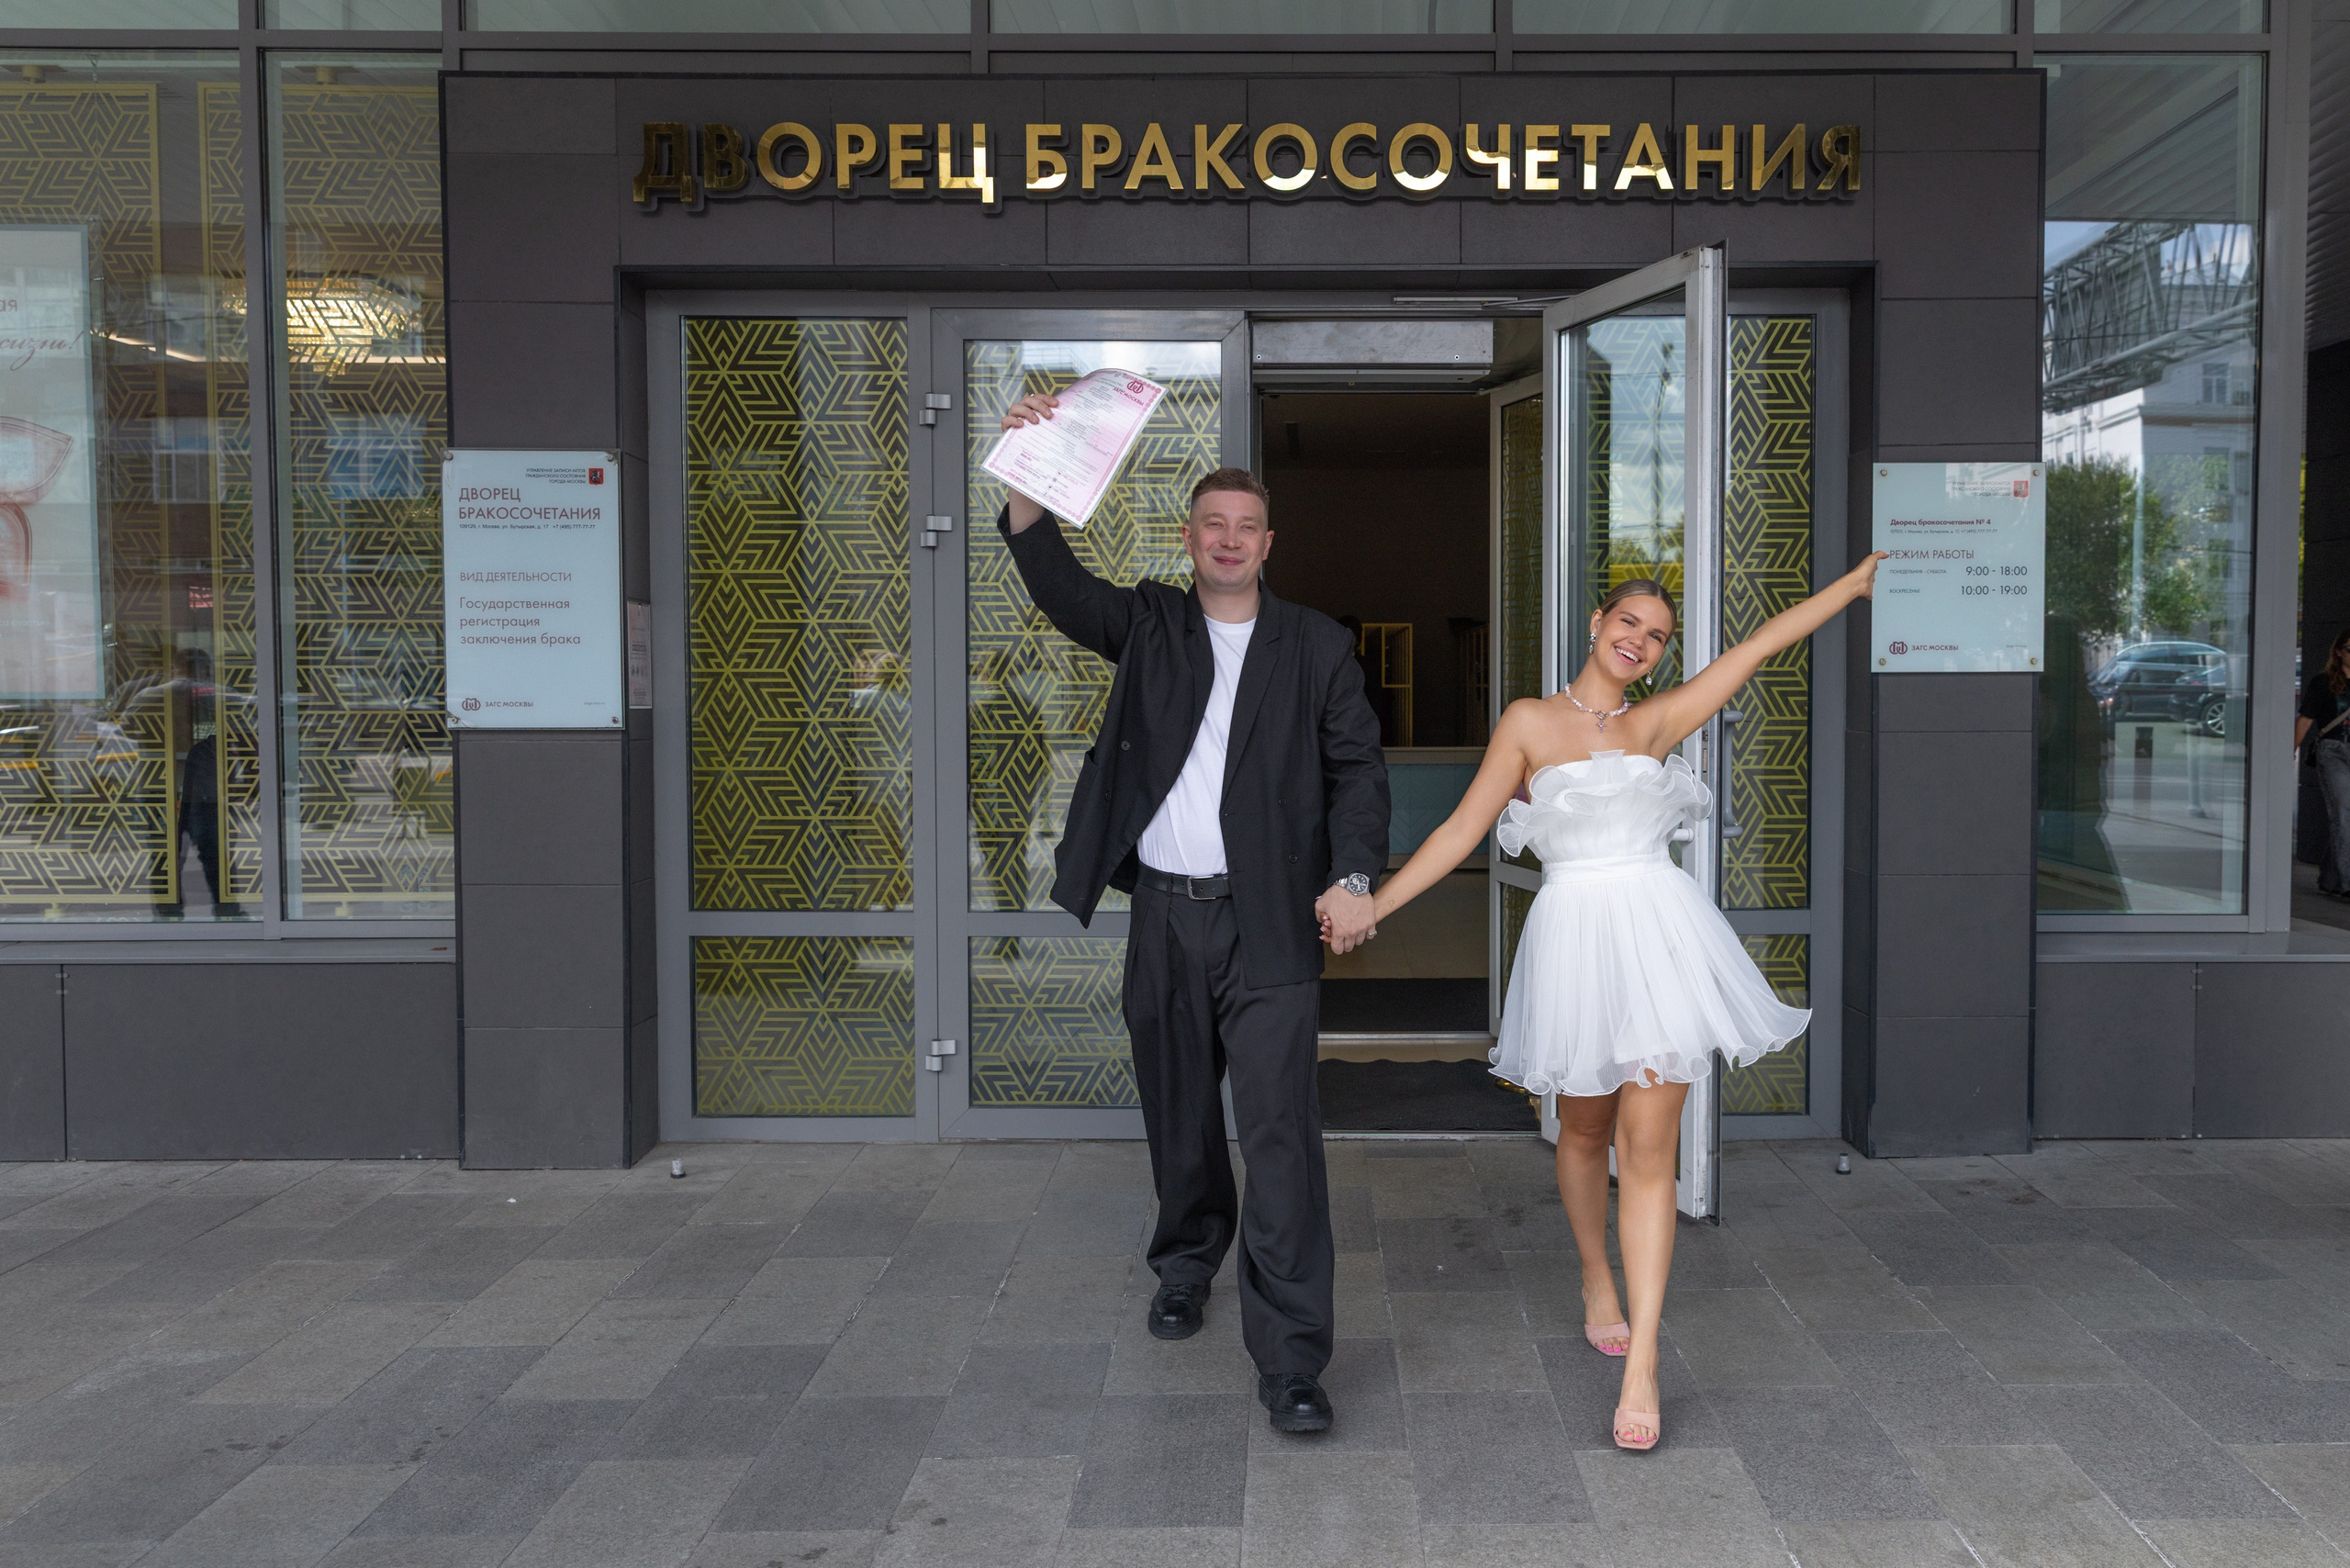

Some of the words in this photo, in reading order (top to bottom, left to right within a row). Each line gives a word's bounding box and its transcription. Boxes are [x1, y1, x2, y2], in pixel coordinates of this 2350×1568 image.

[632, 121, 994, 204] ДВОРЕЦ
[1024, 121, 1862, 194] БРАКОСОЧЕТАНИЯ
[459, 487, 520, 502] ДВОРЕЦ
[459, 507, 600, 521] БРАКОСОЧЕТАНИЯ
[1889, 549, 1930, 559] РЕЖИМ
[1932, 549, 1975, 559] РАБОТЫ
[460, 571, 484, 583] ВИД
[486, 571, 572, 583] ДЕЯТЕЛЬНОСТИ
[1965, 566, 1989, 577] 9:00
[1999, 566, 2028, 577] 18:00
[1961, 586, 1989, 595] 10:00
[1999, 586, 2028, 595] 19:00
[459, 597, 570, 612] Государственная
[460, 616, 540, 629] регистрация
[460, 635, 537, 644] заключения
[541, 633, 581, 647] брака
